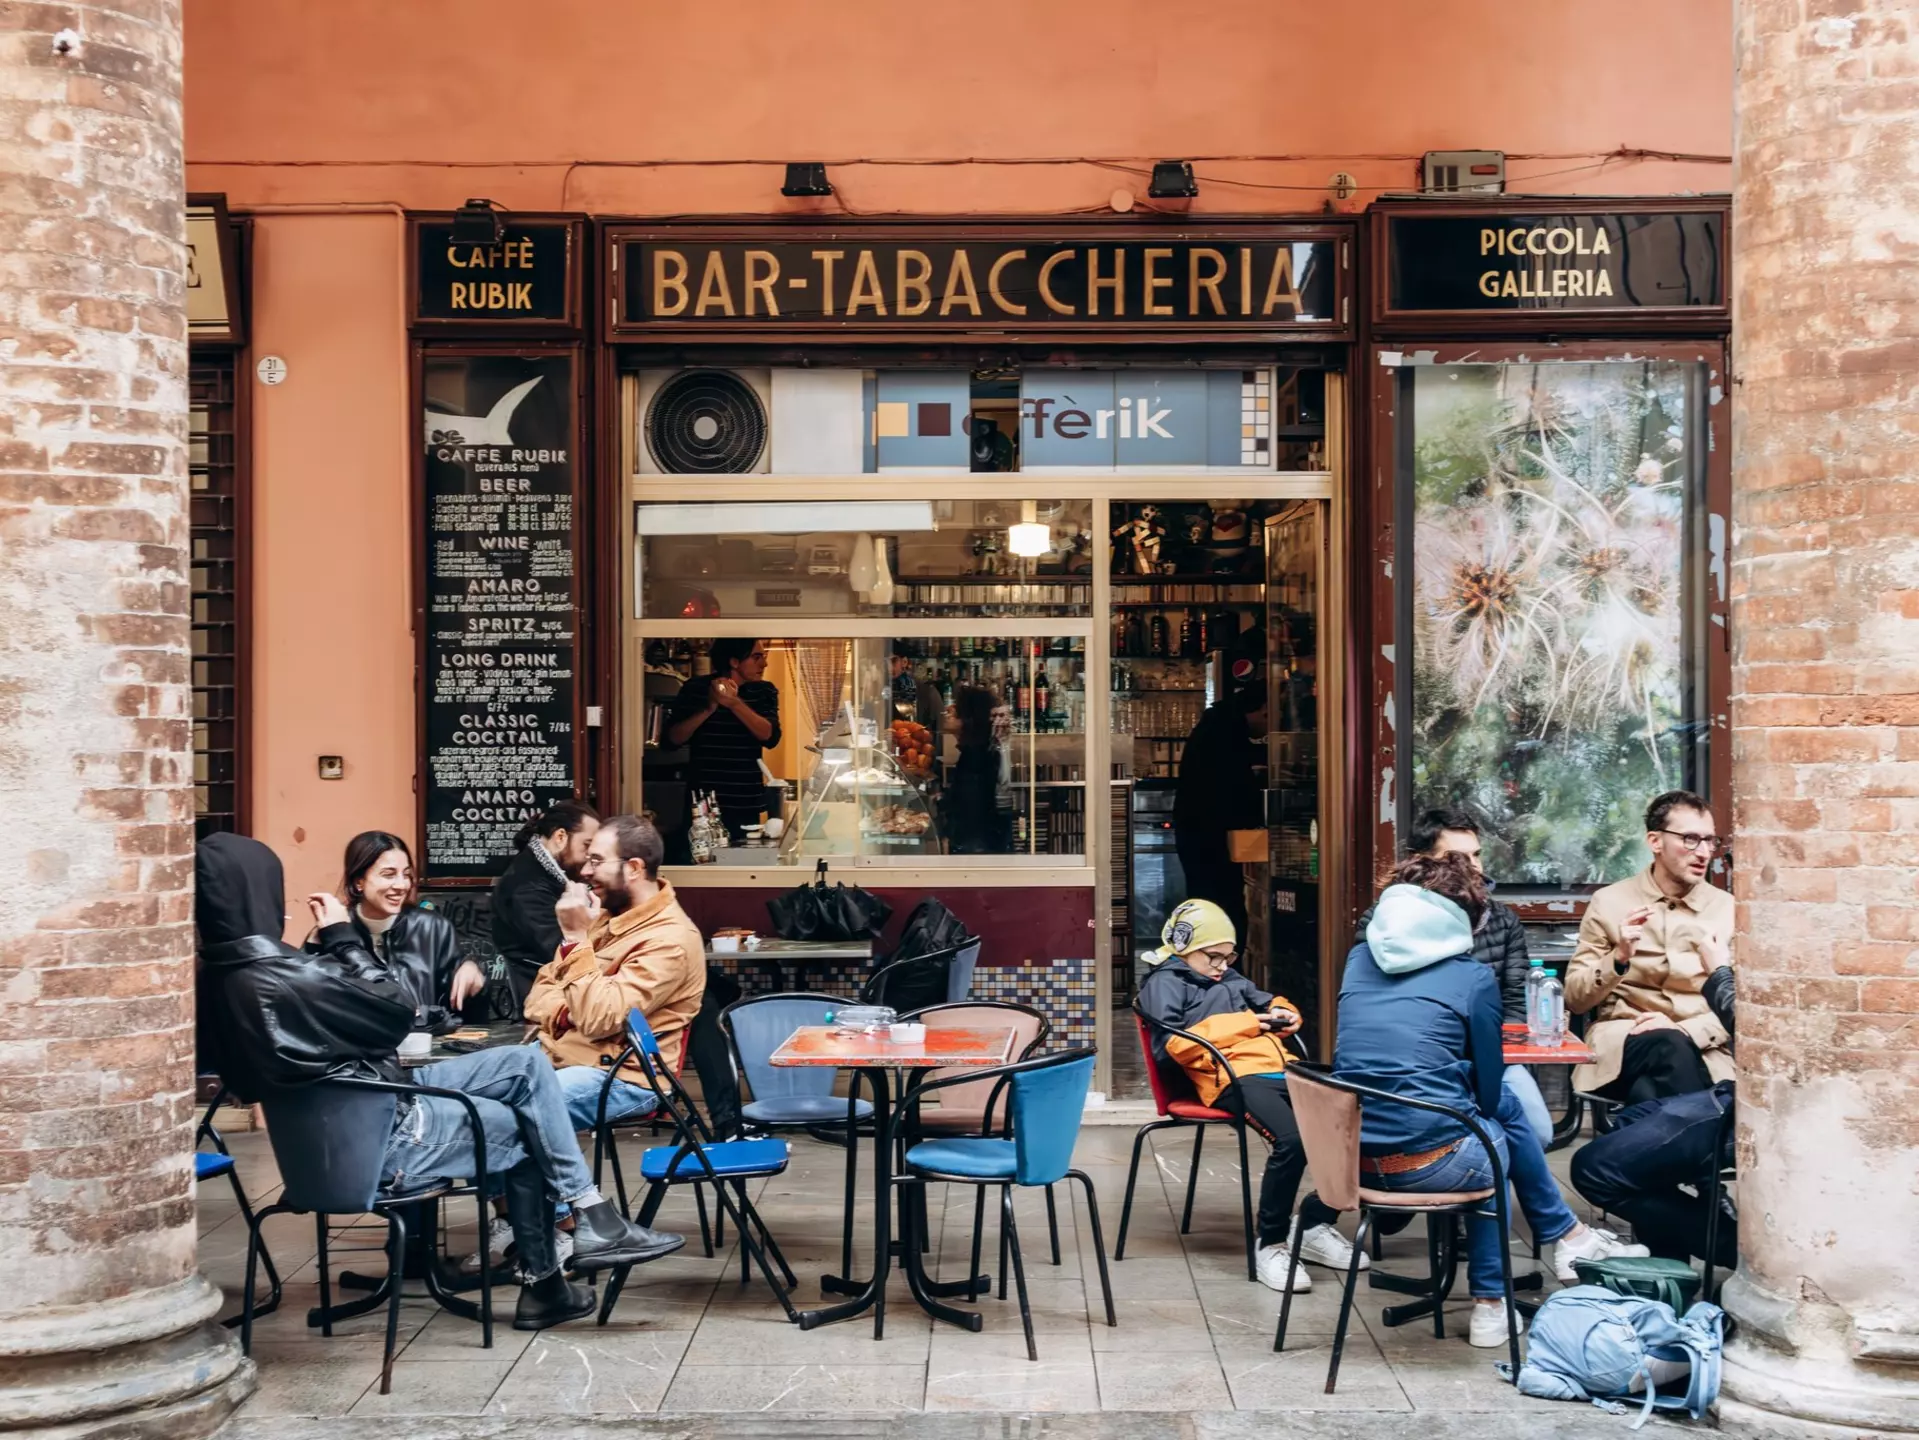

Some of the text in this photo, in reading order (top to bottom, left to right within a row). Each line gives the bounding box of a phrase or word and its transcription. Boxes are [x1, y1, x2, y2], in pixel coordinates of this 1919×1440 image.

[1480, 227, 1612, 256] PICCOLA
[653, 247, 1305, 317] BAR-TABACCHERIA
[1478, 269, 1614, 298] GALLERIA
[451, 282, 533, 310] RUBIK
[511, 449, 567, 463] RUBIK
[480, 478, 531, 492] BEER
[478, 536, 530, 550] WINE
[467, 578, 541, 593] AMARO
[468, 618, 536, 632] SPRITZ
[441, 653, 558, 667] LONG DRINK
[459, 714, 539, 728] CLASSIC
[452, 730, 547, 744] COCKTAIL
[462, 790, 535, 804] AMARO
